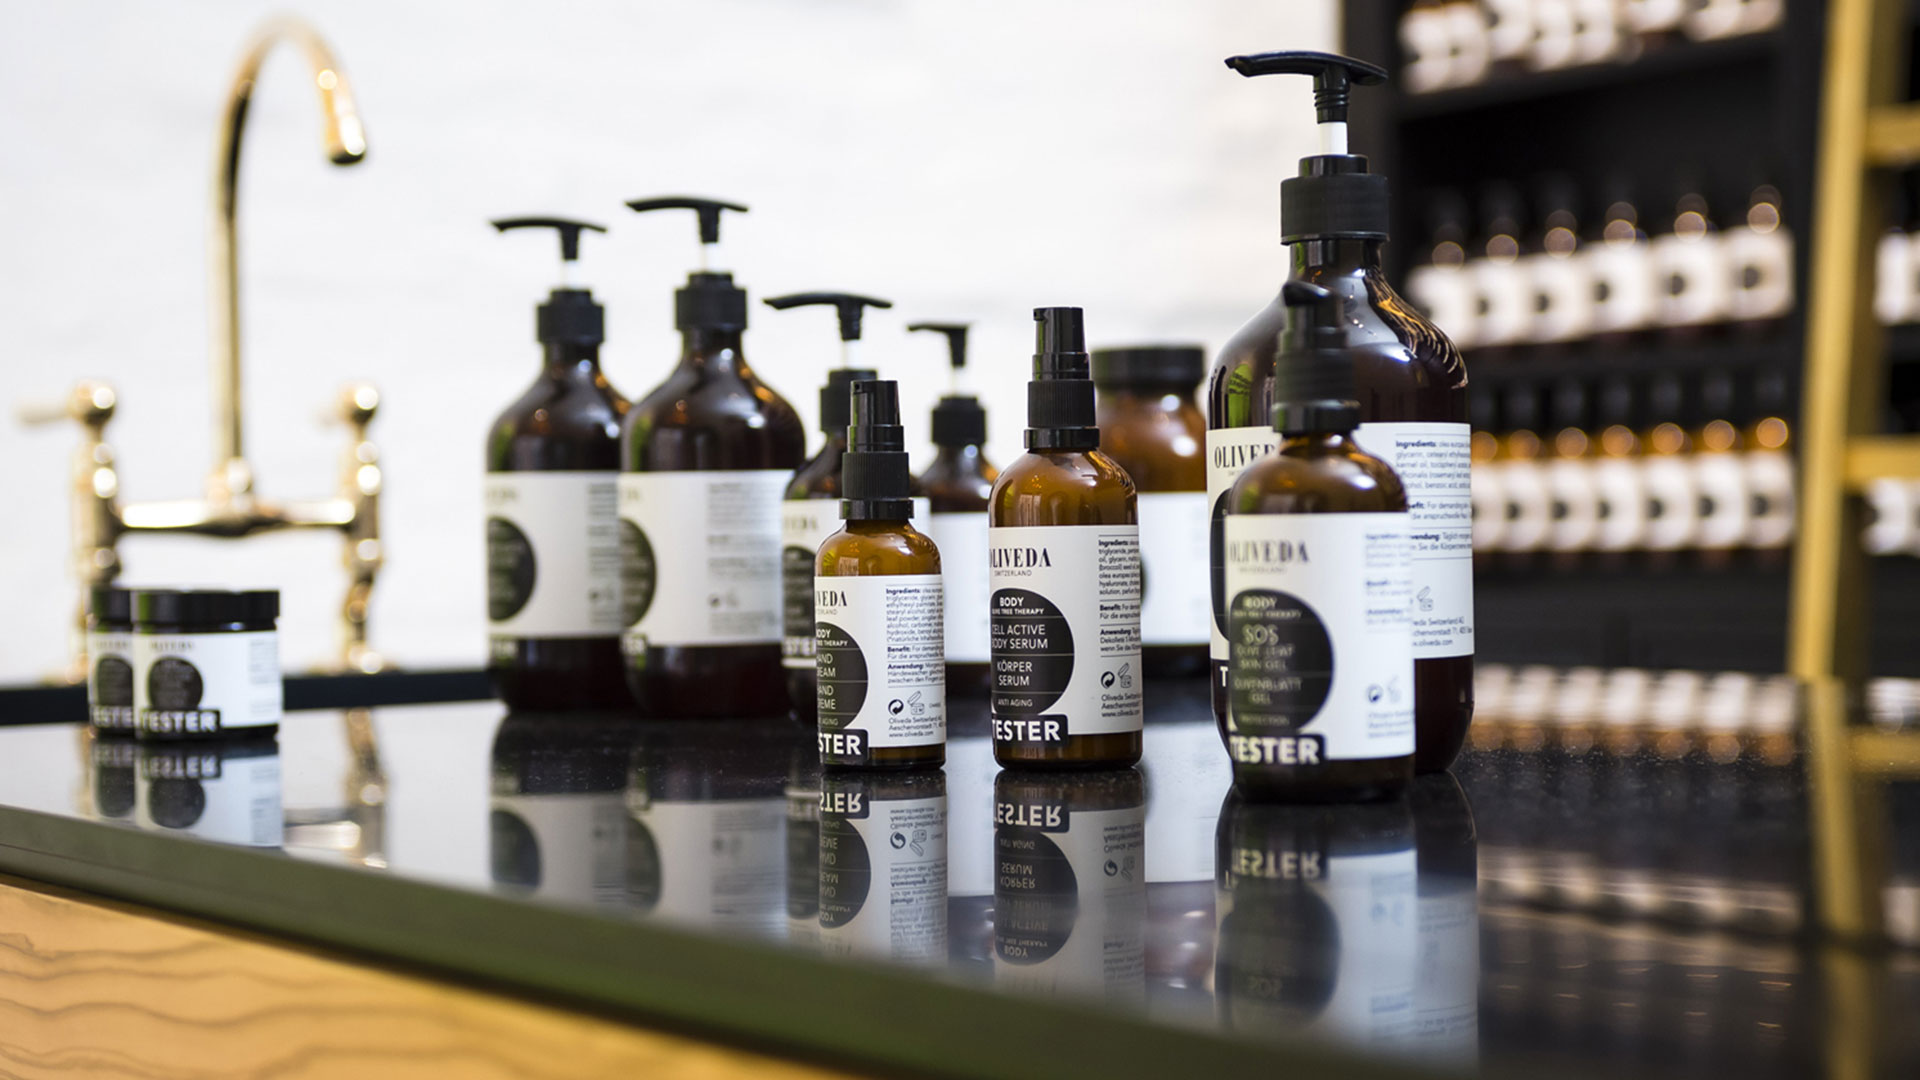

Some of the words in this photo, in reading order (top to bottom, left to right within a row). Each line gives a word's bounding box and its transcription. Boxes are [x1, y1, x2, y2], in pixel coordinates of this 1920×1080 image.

[816, 590, 848, 607] VEDA
[999, 597, 1024, 607] BODY
[816, 629, 831, 639] ODY
[1007, 624, 1046, 635] ACTIVE
[1242, 624, 1279, 646] SOS
[1010, 638, 1048, 649] SERUM
[817, 653, 834, 664] AND
[817, 666, 836, 677] EAM
[997, 659, 1033, 673] KÖRPER
[998, 674, 1030, 686] SERUM
[817, 684, 835, 696] AND
[818, 698, 836, 710] EME
[1010, 699, 1033, 707] AGING
[142, 710, 217, 732] TESTER
[818, 732, 862, 755] STER
[1229, 735, 1321, 765] TESTER
